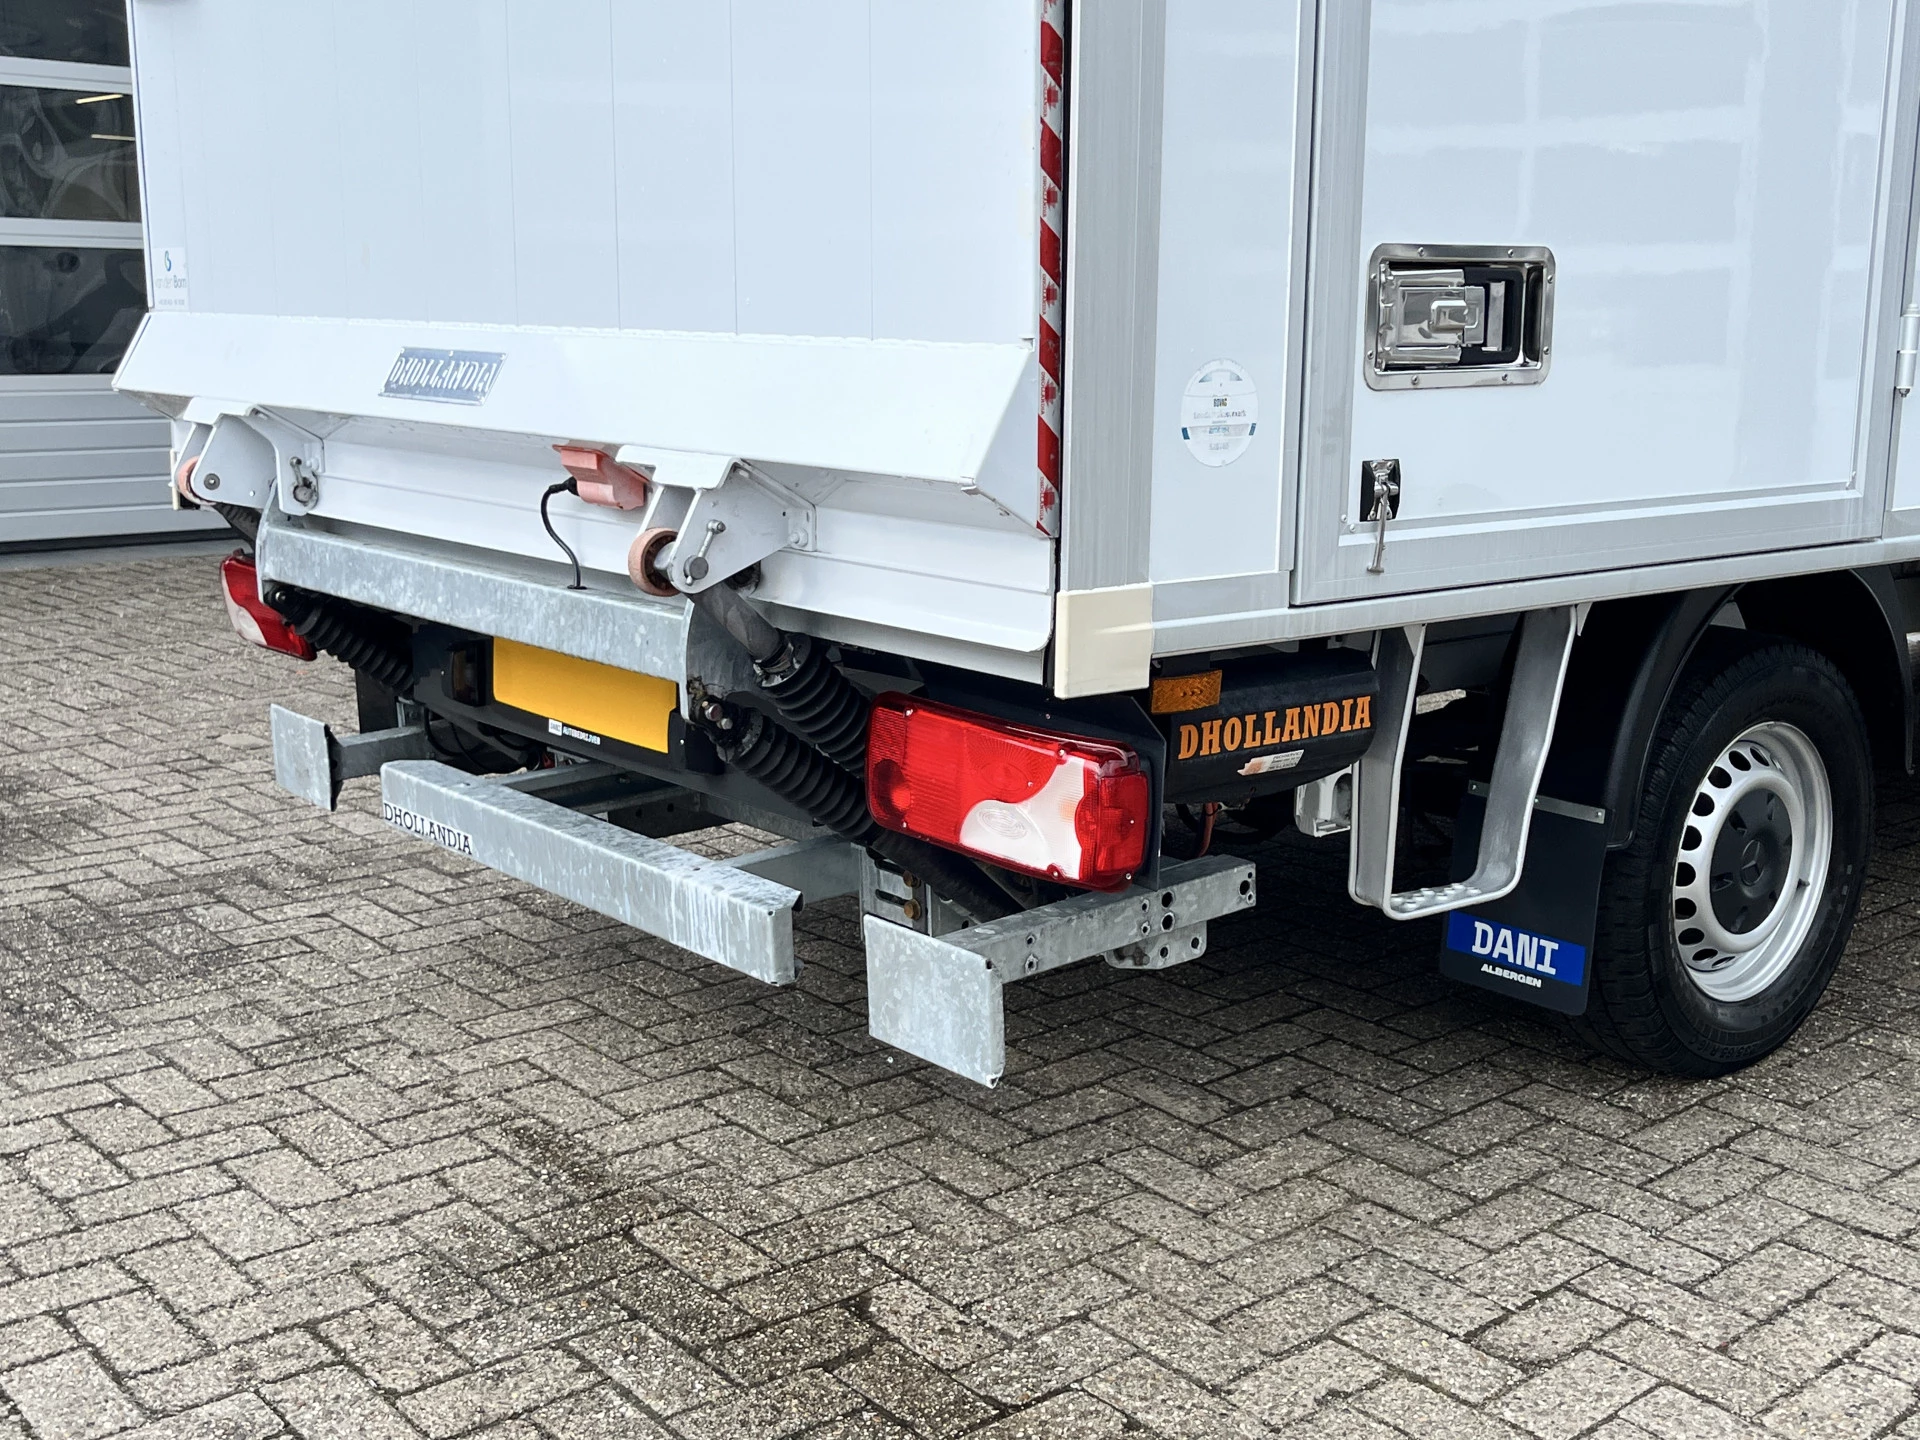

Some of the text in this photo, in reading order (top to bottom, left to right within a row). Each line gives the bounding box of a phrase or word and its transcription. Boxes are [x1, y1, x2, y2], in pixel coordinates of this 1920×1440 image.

[1178, 696, 1371, 760] DHOLLANDIA
[383, 802, 472, 856] DHOLLANDIA
[1472, 921, 1559, 975] DANI
[1481, 963, 1542, 989] ALBERGEN
